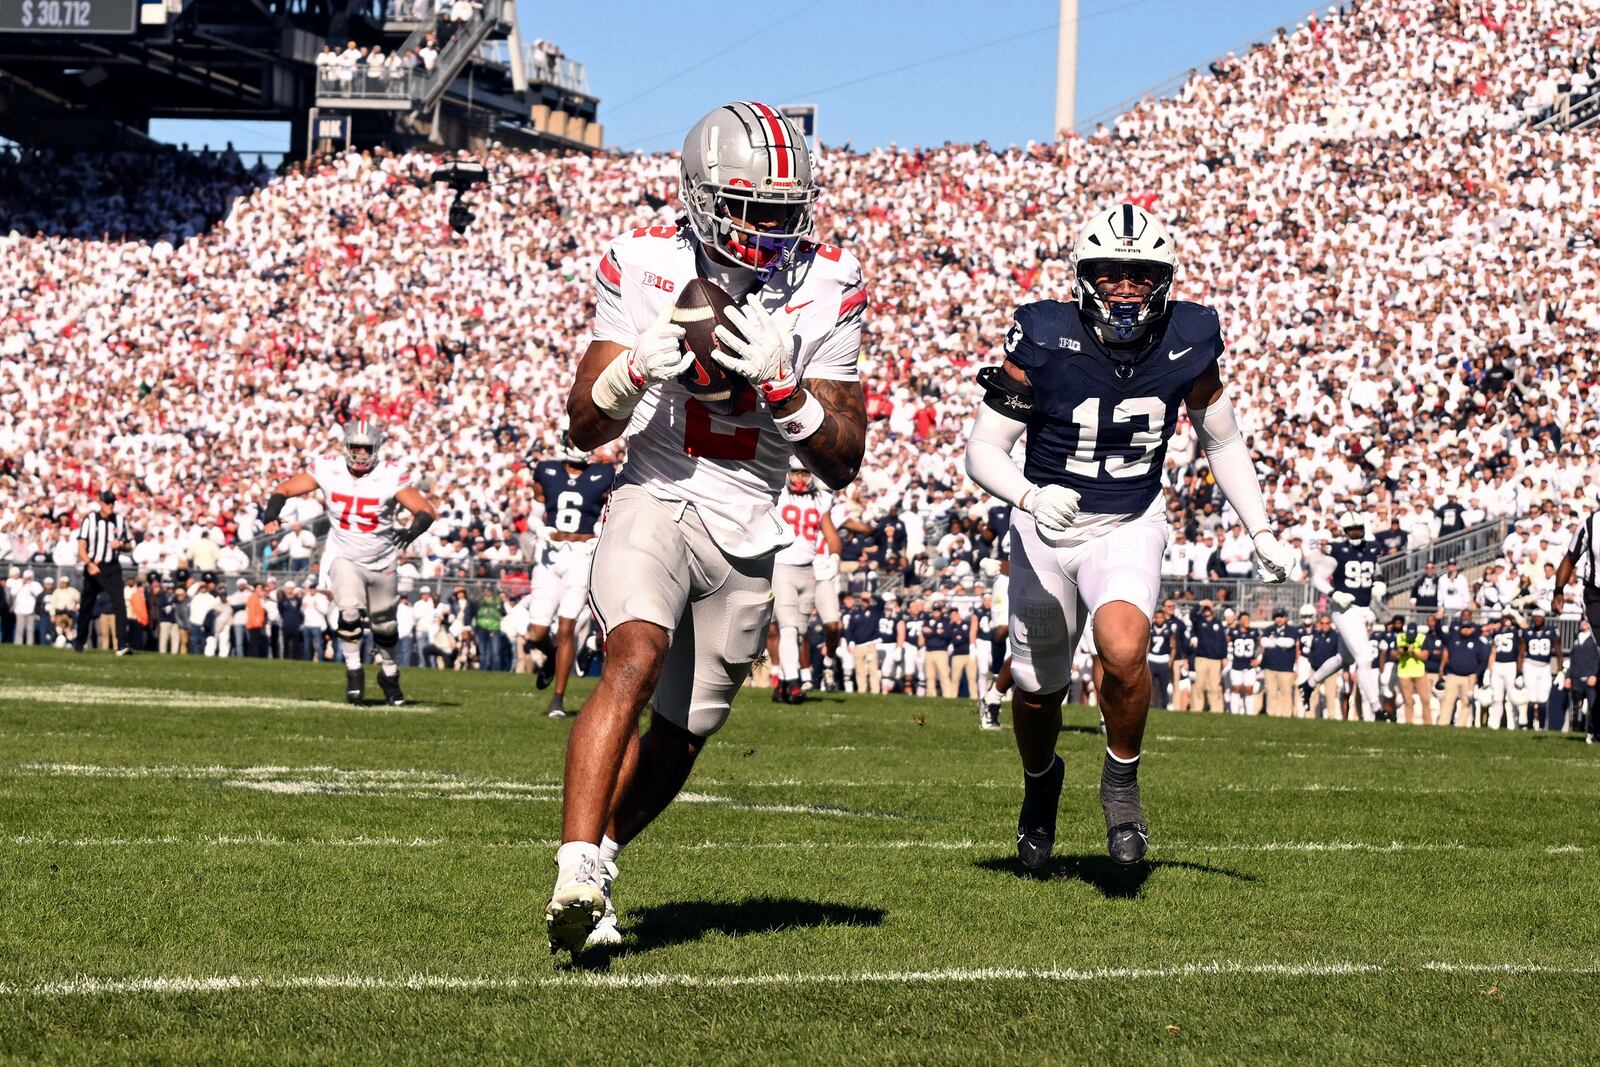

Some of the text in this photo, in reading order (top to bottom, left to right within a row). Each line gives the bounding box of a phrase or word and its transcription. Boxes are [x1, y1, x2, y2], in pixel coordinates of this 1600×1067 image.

[21, 0, 91, 27] $ 30,712
[683, 384, 761, 461] 2
[1065, 396, 1167, 478] 13
[331, 492, 380, 533] 75
[555, 491, 583, 533] 6
[781, 504, 821, 541] 98
[1344, 560, 1375, 588] 92
[1017, 603, 1058, 618] JESUS
[1152, 636, 1164, 653] 7
[1234, 638, 1255, 657] 83
[1528, 638, 1551, 656] 88
